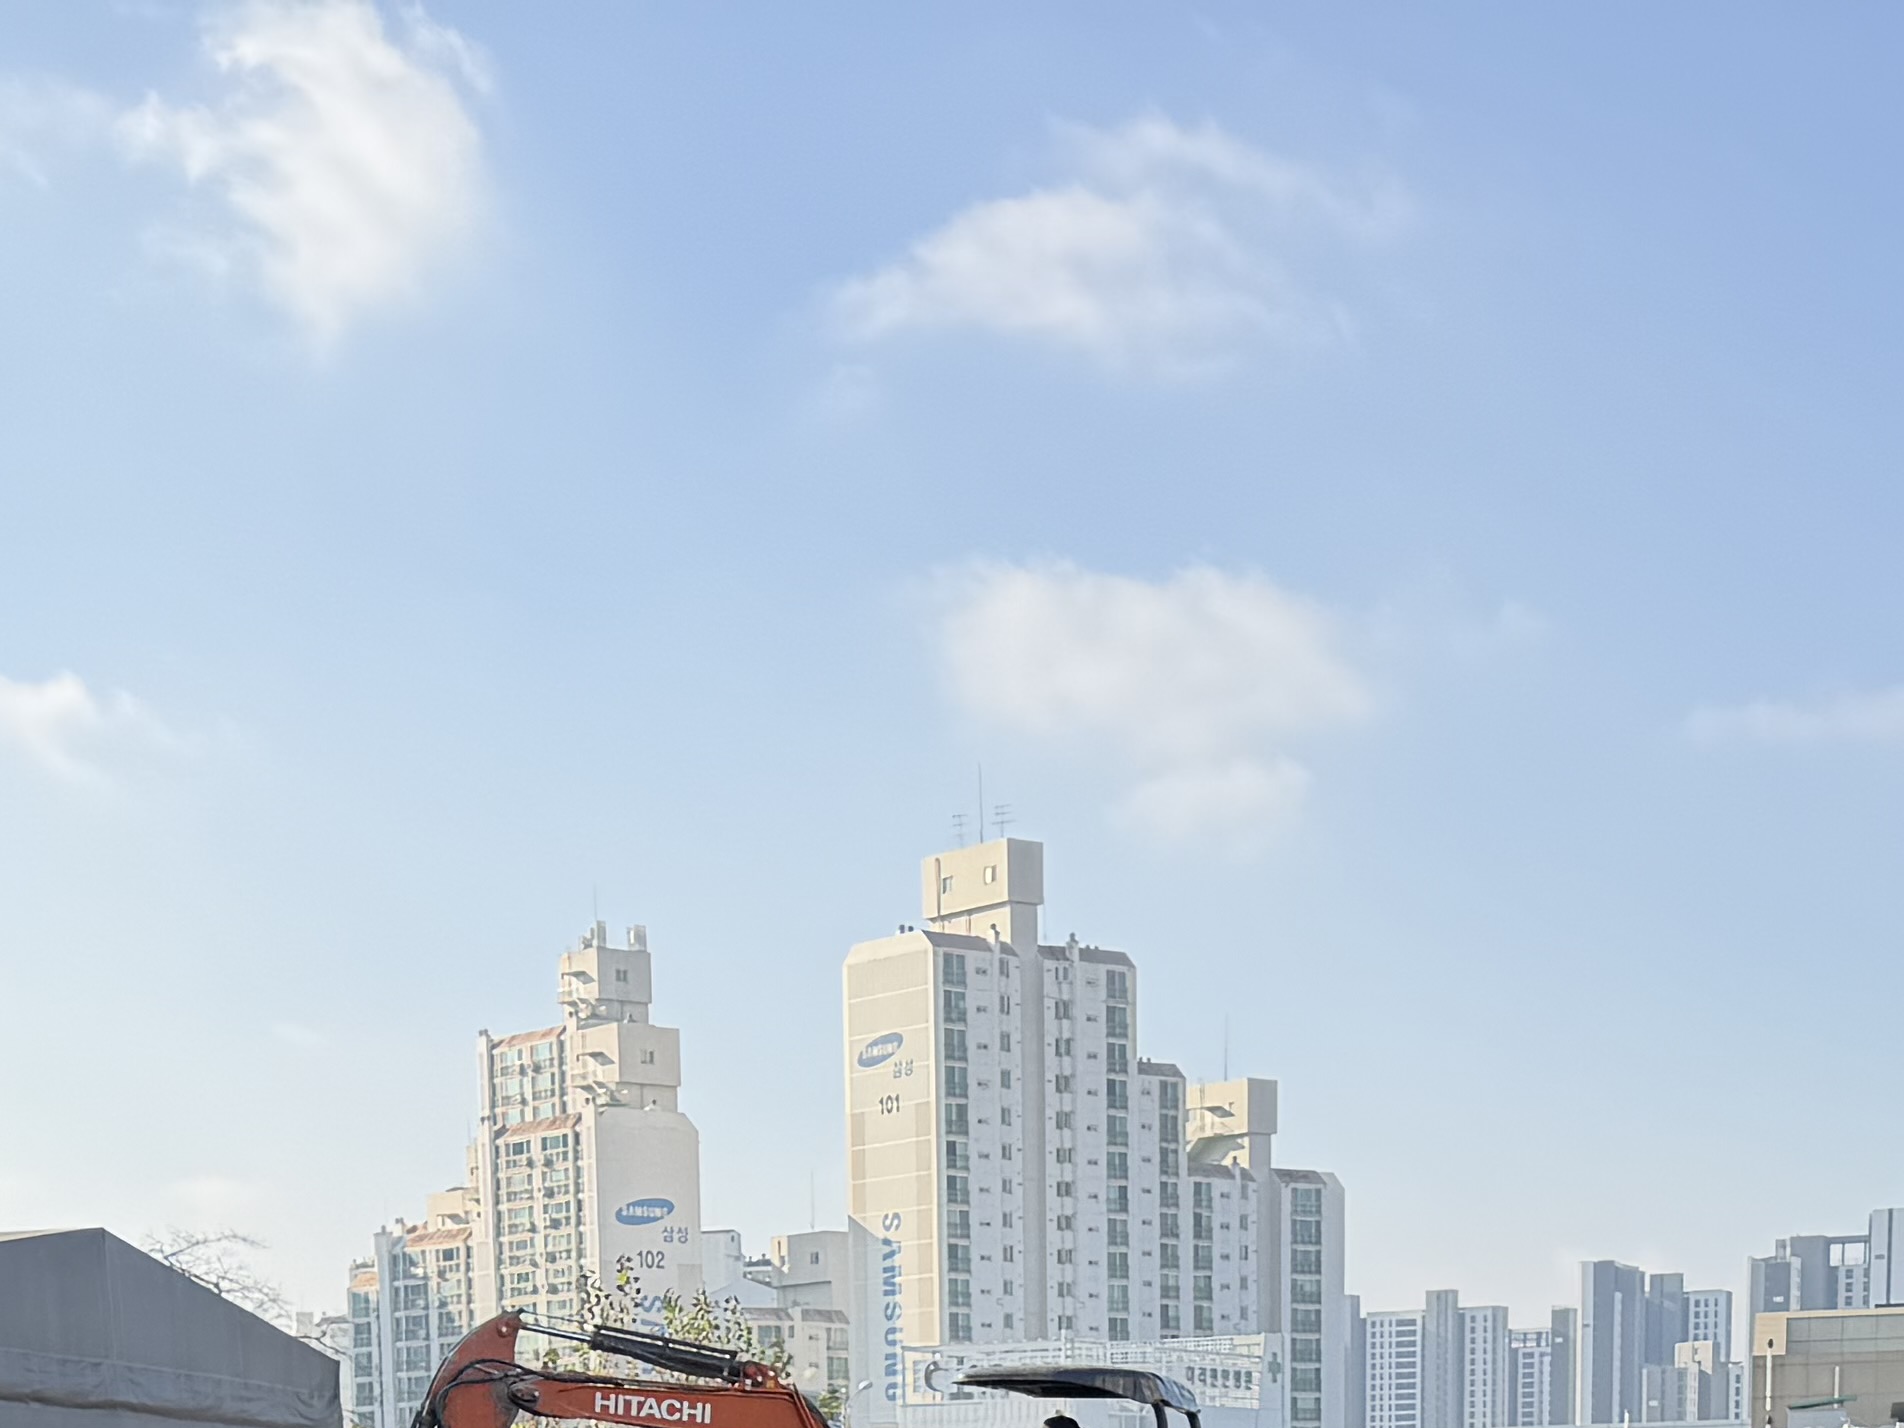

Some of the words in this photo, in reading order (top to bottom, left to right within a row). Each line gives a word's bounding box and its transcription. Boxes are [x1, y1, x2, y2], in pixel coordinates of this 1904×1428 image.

[893, 1058, 914, 1079] 삼성
[878, 1093, 900, 1115] 101
[661, 1226, 689, 1244] 삼성
[636, 1250, 665, 1269] 102
[881, 1212, 903, 1402] SAMSUNG
[594, 1391, 712, 1424] HITACHI
